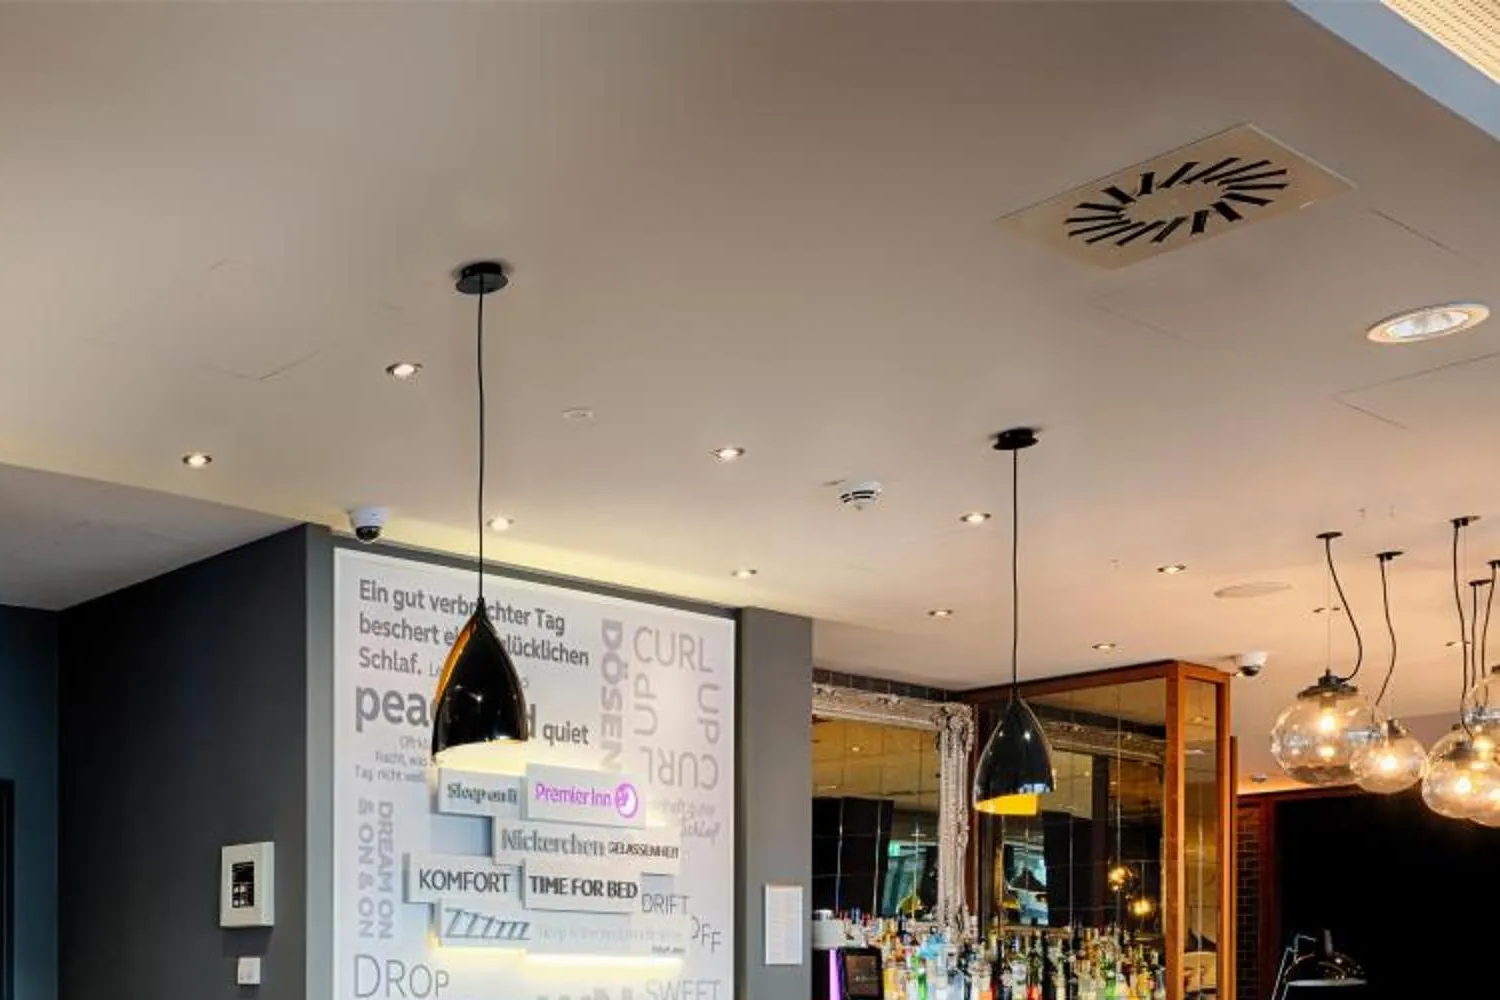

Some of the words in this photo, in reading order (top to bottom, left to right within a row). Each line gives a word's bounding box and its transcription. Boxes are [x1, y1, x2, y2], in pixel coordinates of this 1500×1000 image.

[359, 579, 389, 605] Ein
[393, 589, 424, 611] gut
[534, 608, 565, 637] Tag
[359, 612, 439, 647] beschert
[633, 627, 714, 673] CURL
[359, 646, 421, 674] Schlaf.
[356, 685, 437, 733] pea
[601, 619, 629, 770] DÖSEN
[633, 672, 658, 736] UP
[698, 683, 721, 744] UP
[543, 720, 589, 749] quiet
[640, 746, 719, 791] CURL
[535, 783, 589, 805] Premier
[591, 788, 612, 807] Inn
[358, 824, 374, 865] ON
[378, 801, 393, 893] DREAM
[419, 869, 511, 894] KOMFORT
[529, 874, 567, 898] TIME
[571, 877, 605, 899] FOR
[607, 877, 638, 900] BED
[358, 897, 374, 939] ON
[378, 900, 394, 940] ON
[641, 893, 691, 916] DRIFT
[354, 953, 450, 999] DROP
